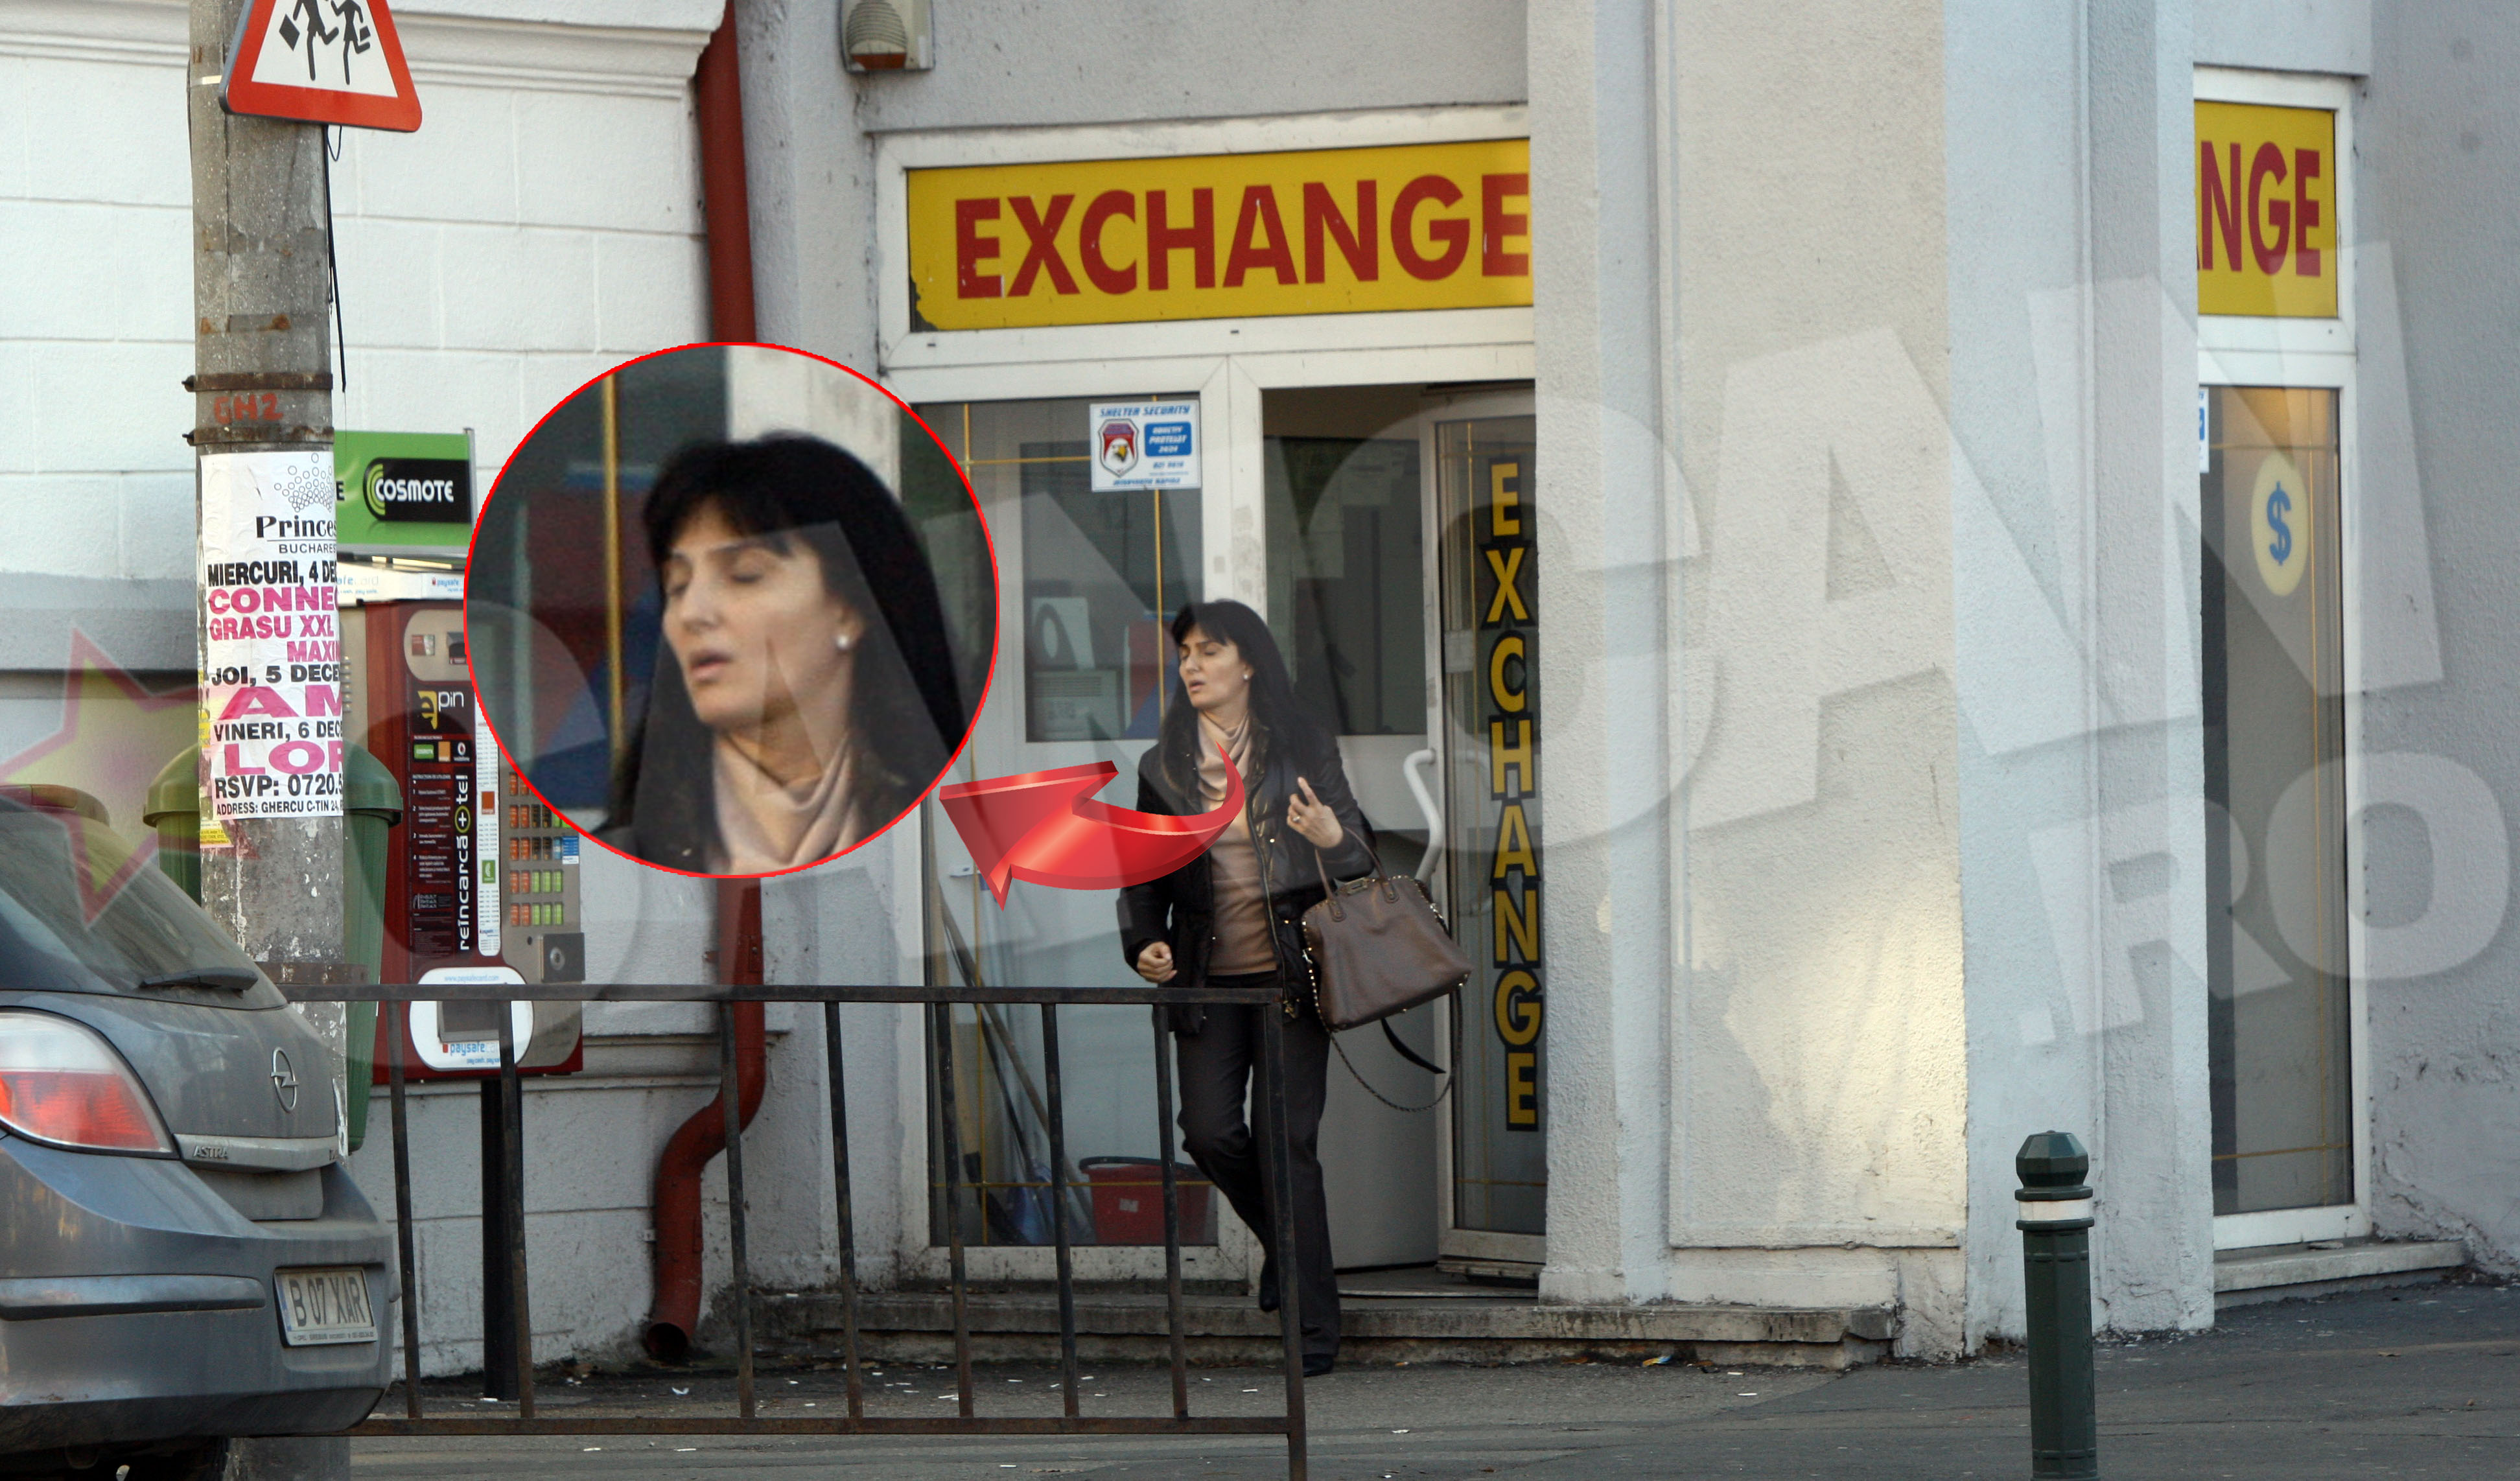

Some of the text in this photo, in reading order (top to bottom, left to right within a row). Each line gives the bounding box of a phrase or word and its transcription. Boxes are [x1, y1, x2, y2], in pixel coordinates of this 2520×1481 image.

[2197, 141, 2322, 277] NGE
[955, 173, 1530, 299] EXCHANGE
[1143, 405, 1191, 416] SECURITY
[375, 478, 454, 502] COSMOTE
[207, 561, 305, 586] MIERCURI,
[309, 561, 319, 583] 4
[209, 614, 334, 641] GRASU XXL
[211, 666, 257, 686] JOI,
[266, 666, 282, 683] 5
[214, 722, 290, 741] VINERI,
[298, 721, 310, 738] 6
[215, 775, 279, 799] RSVP:
[1483, 461, 1543, 1126] EXCHANGE
[216, 801, 259, 816] ADDRESS:
[261, 800, 304, 813] GHERCU
[193, 1145, 229, 1160] ASTRA
[289, 1278, 307, 1327] B
[329, 1275, 367, 1325] XAR
